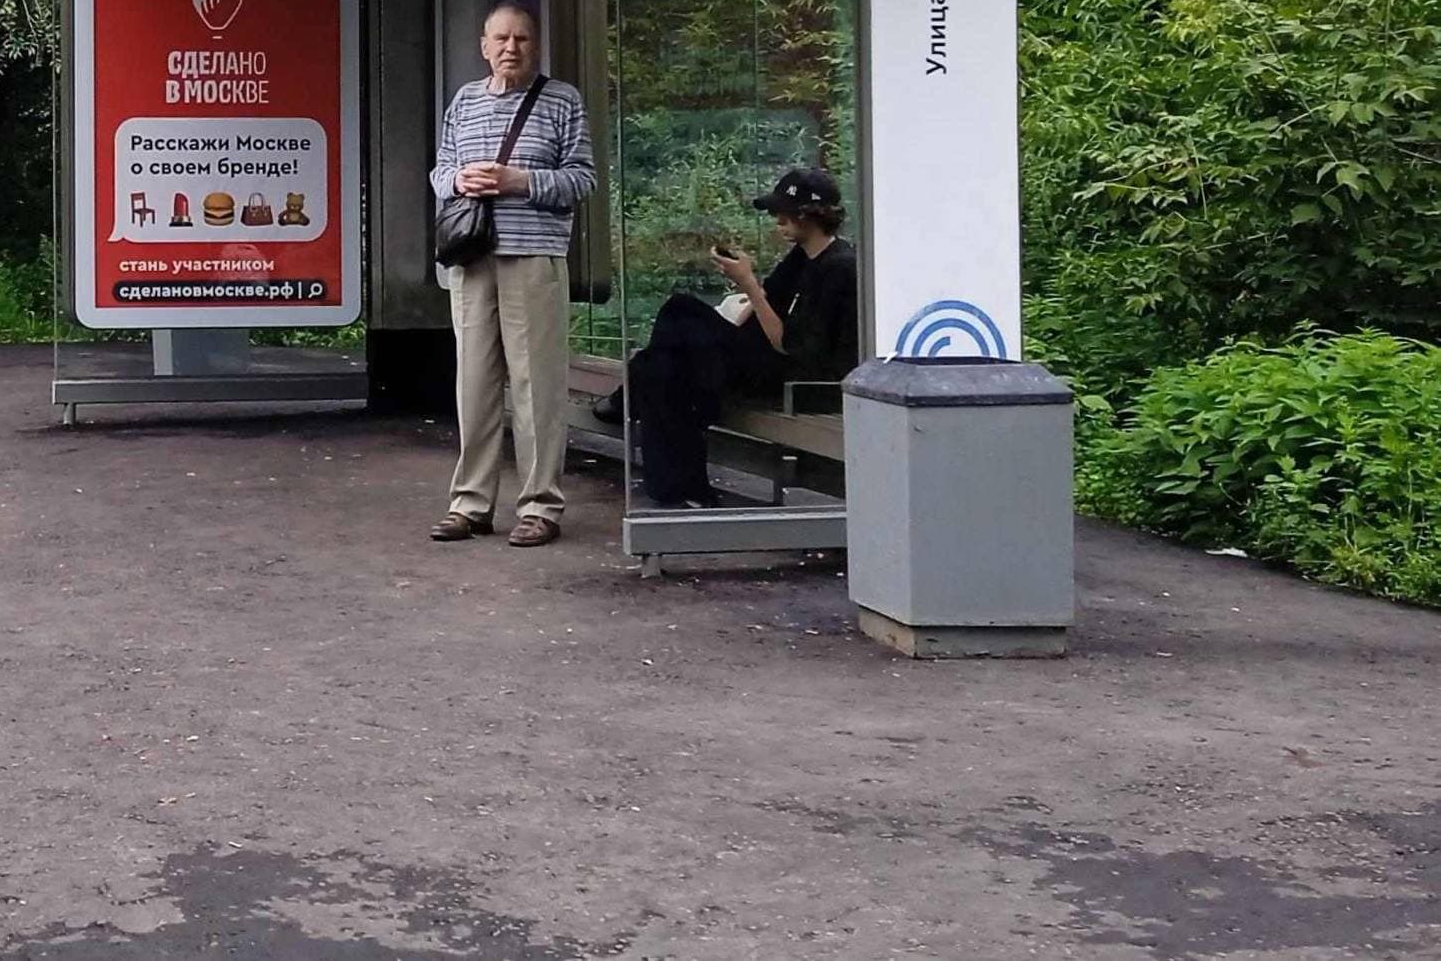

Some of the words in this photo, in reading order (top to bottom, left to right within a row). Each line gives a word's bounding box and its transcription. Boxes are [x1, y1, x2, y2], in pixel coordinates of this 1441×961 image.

[167, 50, 267, 79] СДЕЛАНО
[184, 80, 269, 104] МОСКВЕ
[130, 135, 230, 151] Расскажи
[236, 135, 311, 151] Москве
[130, 162, 143, 176] о
[149, 162, 211, 176] своем
[217, 157, 299, 179] бренде!
[119, 260, 168, 273] стань
[172, 258, 275, 274] участником
[119, 282, 295, 300] сделановмоскве.рф
